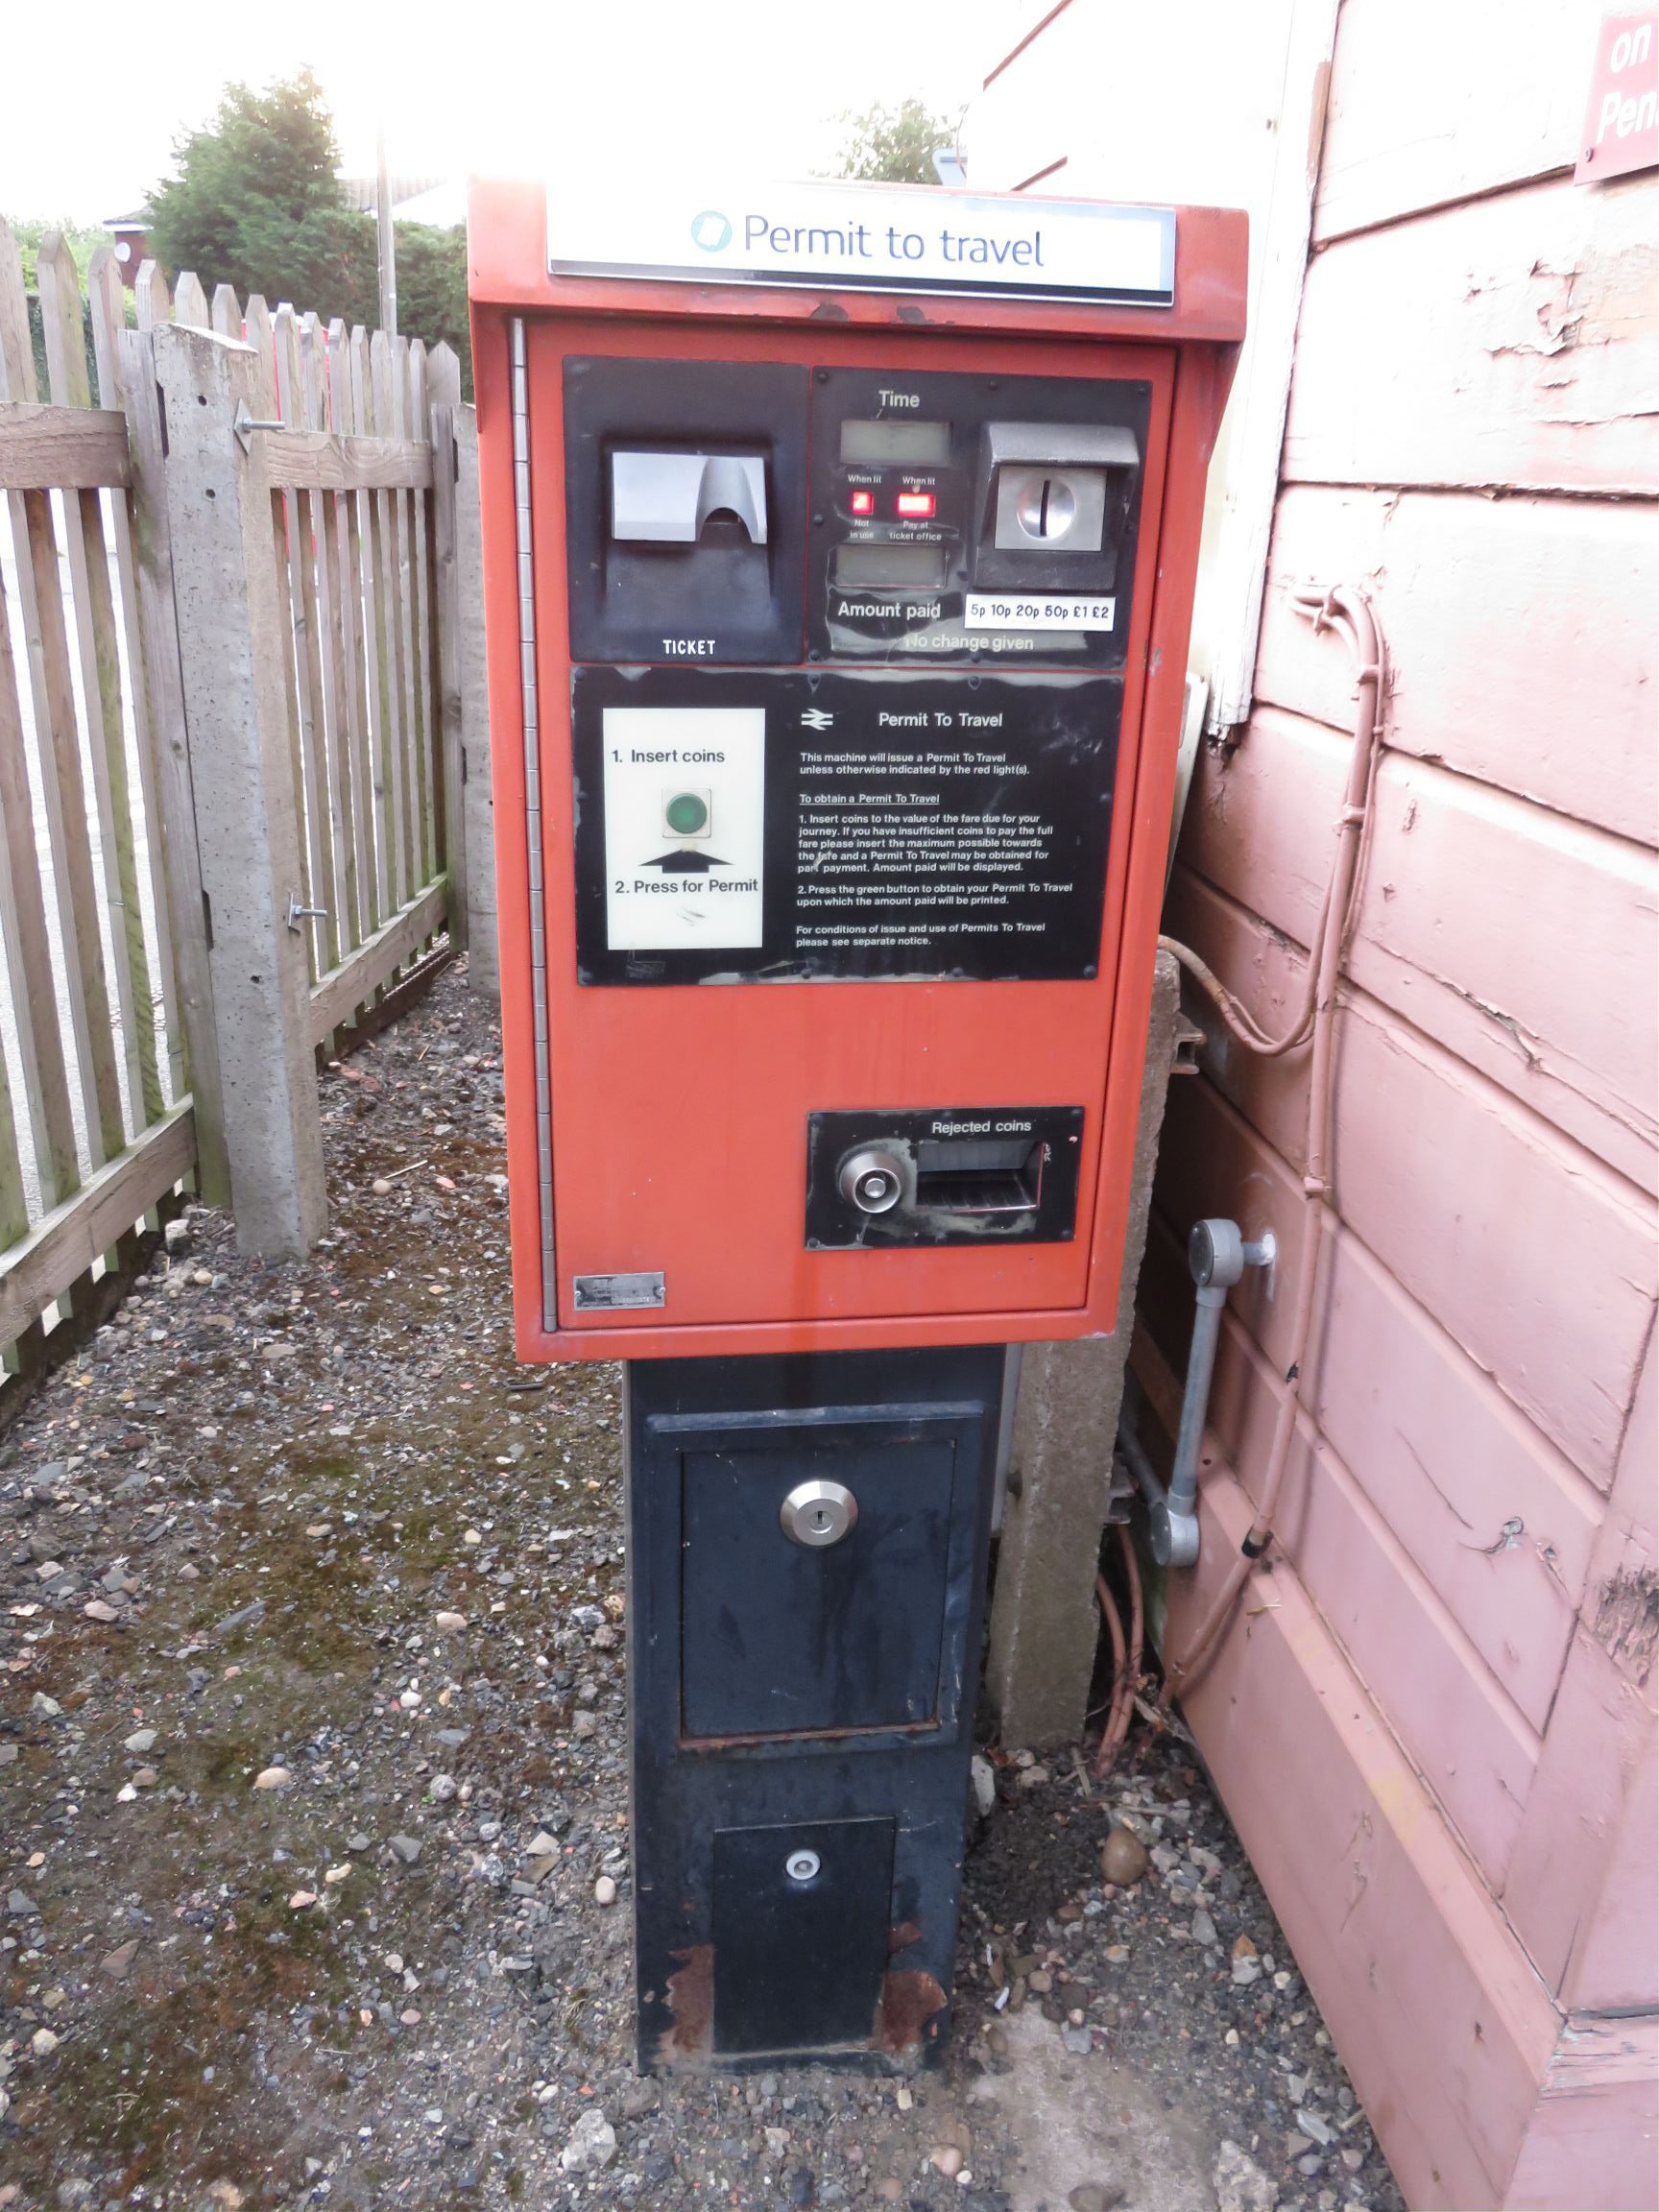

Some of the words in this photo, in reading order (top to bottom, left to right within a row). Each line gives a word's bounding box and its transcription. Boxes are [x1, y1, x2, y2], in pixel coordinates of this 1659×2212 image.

[1610, 23, 1652, 73] on
[1597, 90, 1659, 144] Pen
[745, 215, 872, 256] Permit
[887, 227, 924, 259] to
[939, 230, 1044, 266] travel
[878, 390, 920, 407] Time
[848, 474, 872, 483] When
[902, 476, 926, 486] When
[854, 518, 869, 527] Not
[902, 520, 919, 530] Pay
[888, 530, 913, 539] ticket
[916, 532, 941, 541] office
[838, 601, 901, 616] Amount
[906, 601, 940, 621] paid
[971, 603, 985, 617] 5p
[992, 604, 1010, 618] 10p
[1016, 604, 1039, 618] 20p
[1045, 605, 1068, 619] 50p
[1073, 606, 1087, 617] £1
[1093, 606, 1108, 617] £2
[662, 639, 715, 654] TICKET
[905, 635, 927, 648] No
[931, 635, 988, 652] change
[992, 636, 1033, 651] given
[879, 712, 927, 726] Permit
[934, 712, 951, 726] To
[958, 712, 1002, 726] Travel
[612, 749, 622, 762] 1.
[632, 749, 677, 762] Insert
[682, 749, 725, 761] coins
[800, 753, 822, 761] This
[824, 753, 866, 761] machine
[869, 753, 885, 761] will
[887, 753, 913, 761] issue
[926, 753, 959, 761] Permit
[963, 753, 974, 761] To
[976, 753, 1005, 761] Travel
[800, 765, 832, 774] unless
[835, 764, 886, 774] otherwise
[889, 764, 935, 774] indicated
[939, 765, 950, 775] by
[953, 765, 970, 774] the
[974, 765, 990, 774] red
[993, 764, 1029, 776] light(s).
[800, 794, 812, 804] To
[814, 794, 846, 804] obtain
[859, 794, 891, 804] Permit
[896, 794, 907, 804] To
[910, 794, 939, 804] Travel
[799, 814, 806, 823] 1.
[809, 814, 838, 823] Insert
[841, 814, 868, 823] coins
[871, 814, 881, 823] to
[884, 814, 900, 823] the
[982, 813, 999, 823] due
[1002, 814, 1016, 823] for
[1019, 815, 1040, 824] your
[799, 827, 839, 837] journey.
[843, 827, 849, 835] If
[852, 828, 870, 837] you
[873, 827, 896, 835] have
[899, 826, 953, 834] insufficient
[957, 826, 983, 834] coins
[986, 826, 996, 834] to
[998, 828, 1016, 836] pay
[1019, 826, 1034, 834] the
[1037, 826, 1052, 834] full
[799, 839, 818, 848] fare
[820, 839, 854, 850] please
[906, 838, 954, 847] maximum
[958, 838, 999, 848] possible
[1002, 838, 1042, 847] towards
[798, 852, 814, 860] the
[840, 851, 858, 860] and
[870, 851, 902, 859] Permit
[905, 851, 917, 859] To
[920, 851, 949, 859] Travel
[823, 863, 869, 874] payment.
[915, 862, 936, 873] paid
[939, 862, 955, 871] will
[957, 862, 970, 871] be
[973, 862, 1022, 872] displayed.
[614, 880, 629, 893] 2.
[634, 880, 678, 893] Press
[682, 879, 703, 892] for
[709, 878, 757, 891] Permit
[798, 885, 806, 894] 2.
[808, 884, 836, 894] Press
[838, 884, 854, 893] the
[856, 886, 884, 895] green
[886, 884, 919, 893] button
[967, 885, 988, 894] your
[992, 883, 1024, 892] Permit
[1043, 882, 1072, 891] Travel
[797, 899, 822, 907] upon
[824, 897, 853, 905] which
[914, 896, 936, 905] paid
[956, 896, 968, 904] be
[971, 895, 1008, 905] printed.
[796, 926, 812, 934] For
[815, 925, 866, 933] conditions
[868, 925, 878, 933] of
[908, 924, 926, 932] and
[1001, 923, 1013, 931] To
[796, 938, 828, 948] please
[853, 937, 895, 947] separate
[898, 936, 930, 945] notice.
[931, 1120, 990, 1136] Rejected
[996, 1119, 1031, 1131] coins
